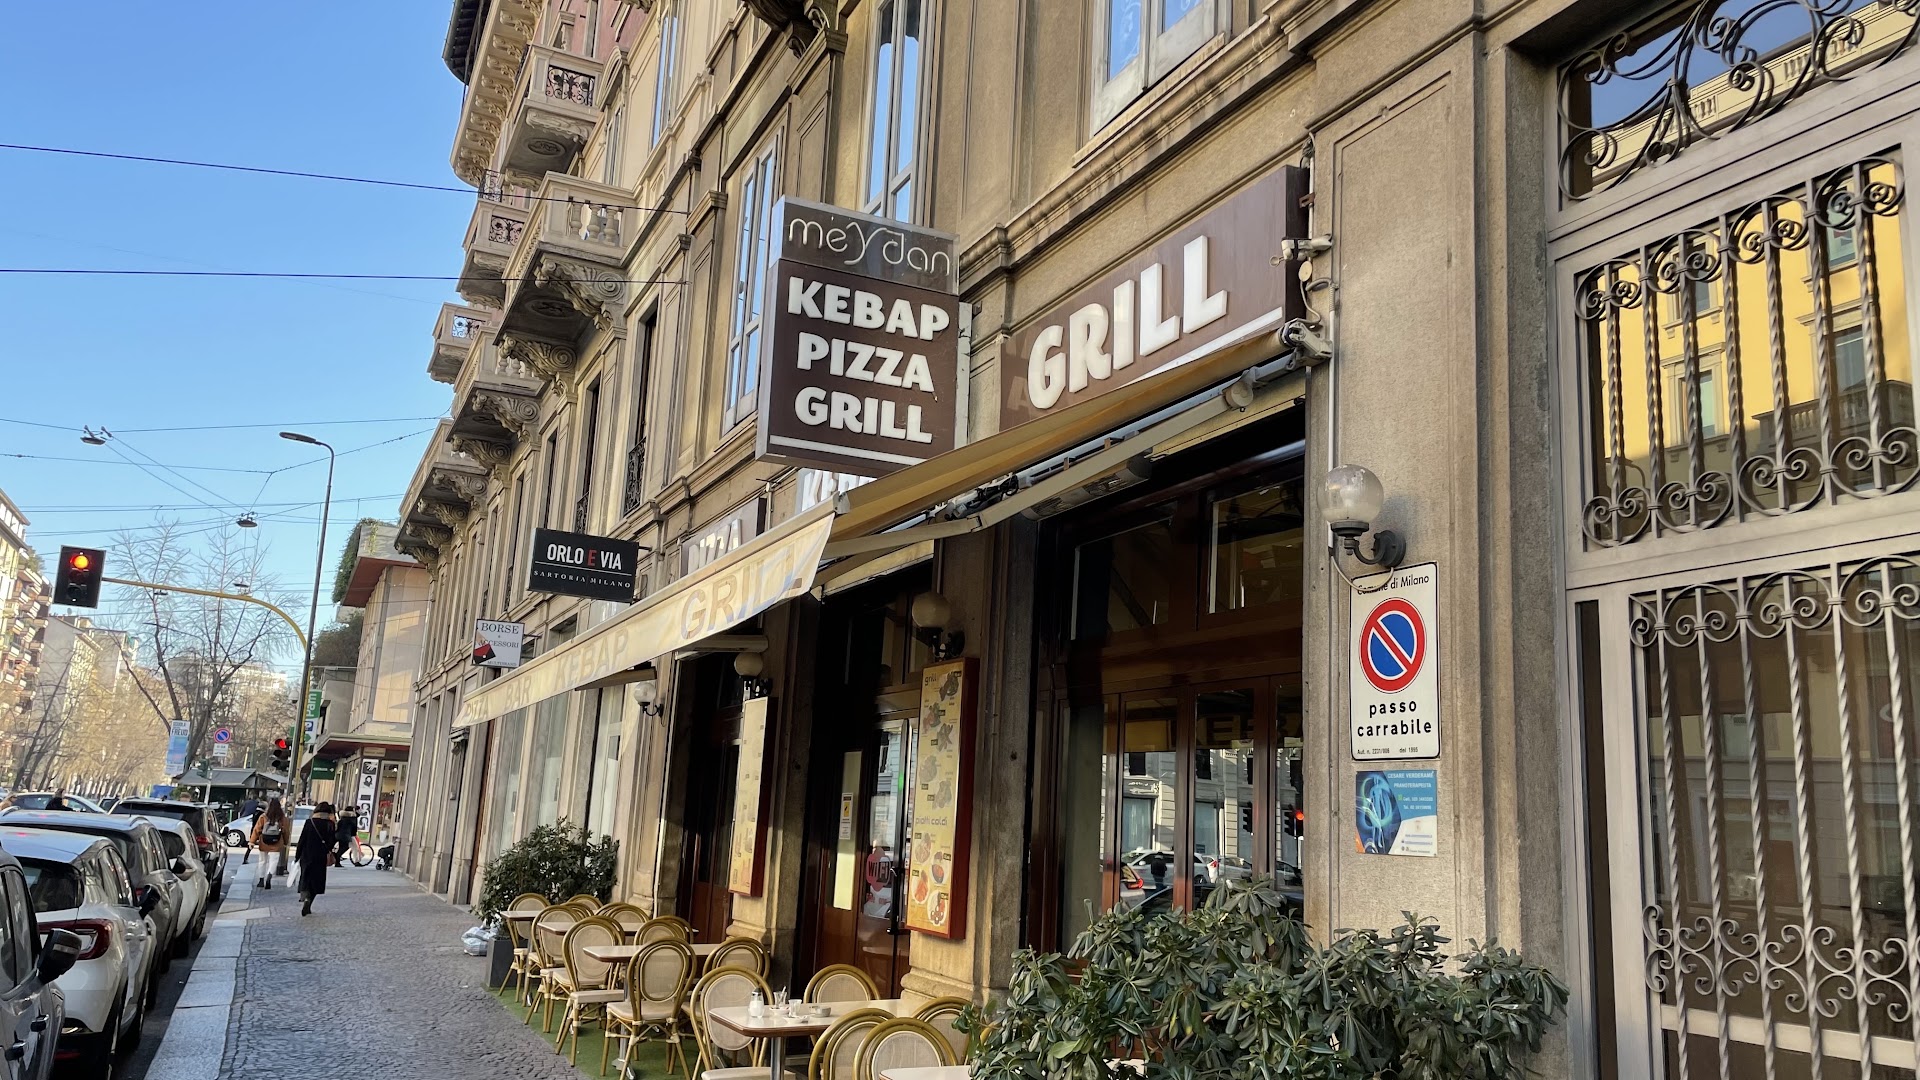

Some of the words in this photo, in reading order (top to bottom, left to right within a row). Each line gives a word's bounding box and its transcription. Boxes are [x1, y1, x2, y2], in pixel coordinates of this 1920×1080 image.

[788, 276, 950, 341] KEBAP
[1028, 235, 1228, 409] GRILL
[797, 331, 935, 392] PIZZA
[794, 386, 933, 444] GRILL
[546, 543, 584, 565] ORLO
[587, 549, 597, 567] E
[600, 550, 622, 571] VIA
[533, 569, 586, 583] SARTORIA
[590, 577, 631, 589] MILANO
[1390, 577, 1399, 589] di
[1400, 573, 1430, 588] Milano
[481, 621, 520, 635] BORSE
[504, 675, 532, 710] BAR
[554, 628, 629, 691] KEBAP
[306, 693, 317, 717] Pam
[1369, 700, 1417, 719] passo
[1357, 718, 1432, 737] carrabile
